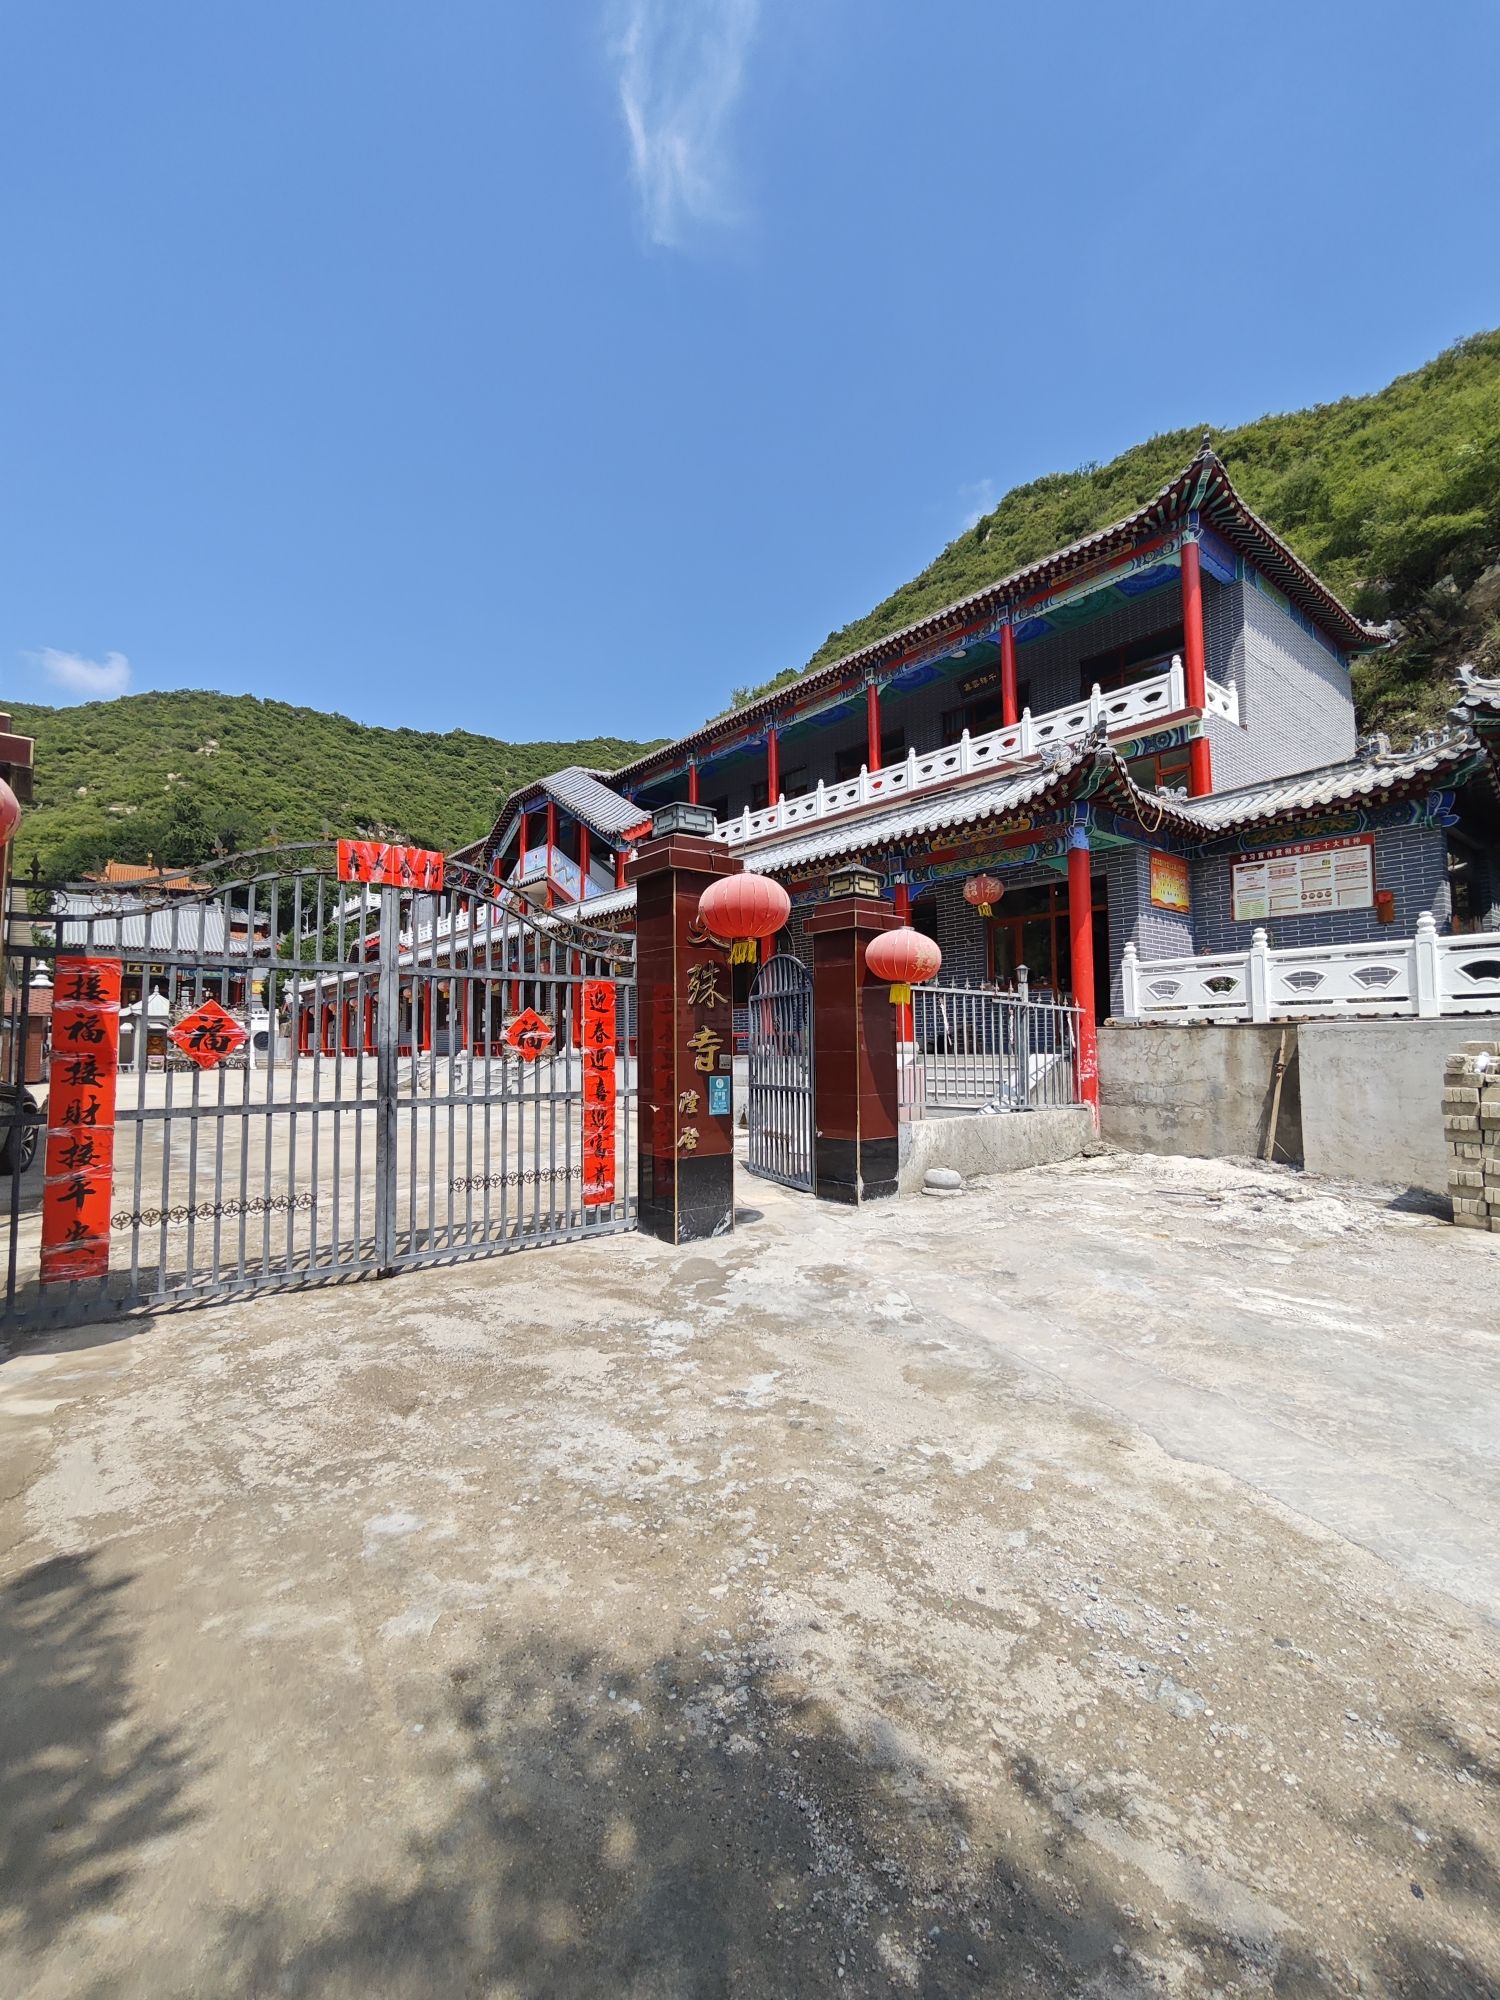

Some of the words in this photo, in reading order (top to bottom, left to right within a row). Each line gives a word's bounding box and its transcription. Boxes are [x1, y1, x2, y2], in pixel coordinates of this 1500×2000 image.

[1240, 837, 1361, 862] 学习宣传贯彻党的二十大精神
[185, 1016, 232, 1053] 福
[515, 1019, 543, 1050] 福
